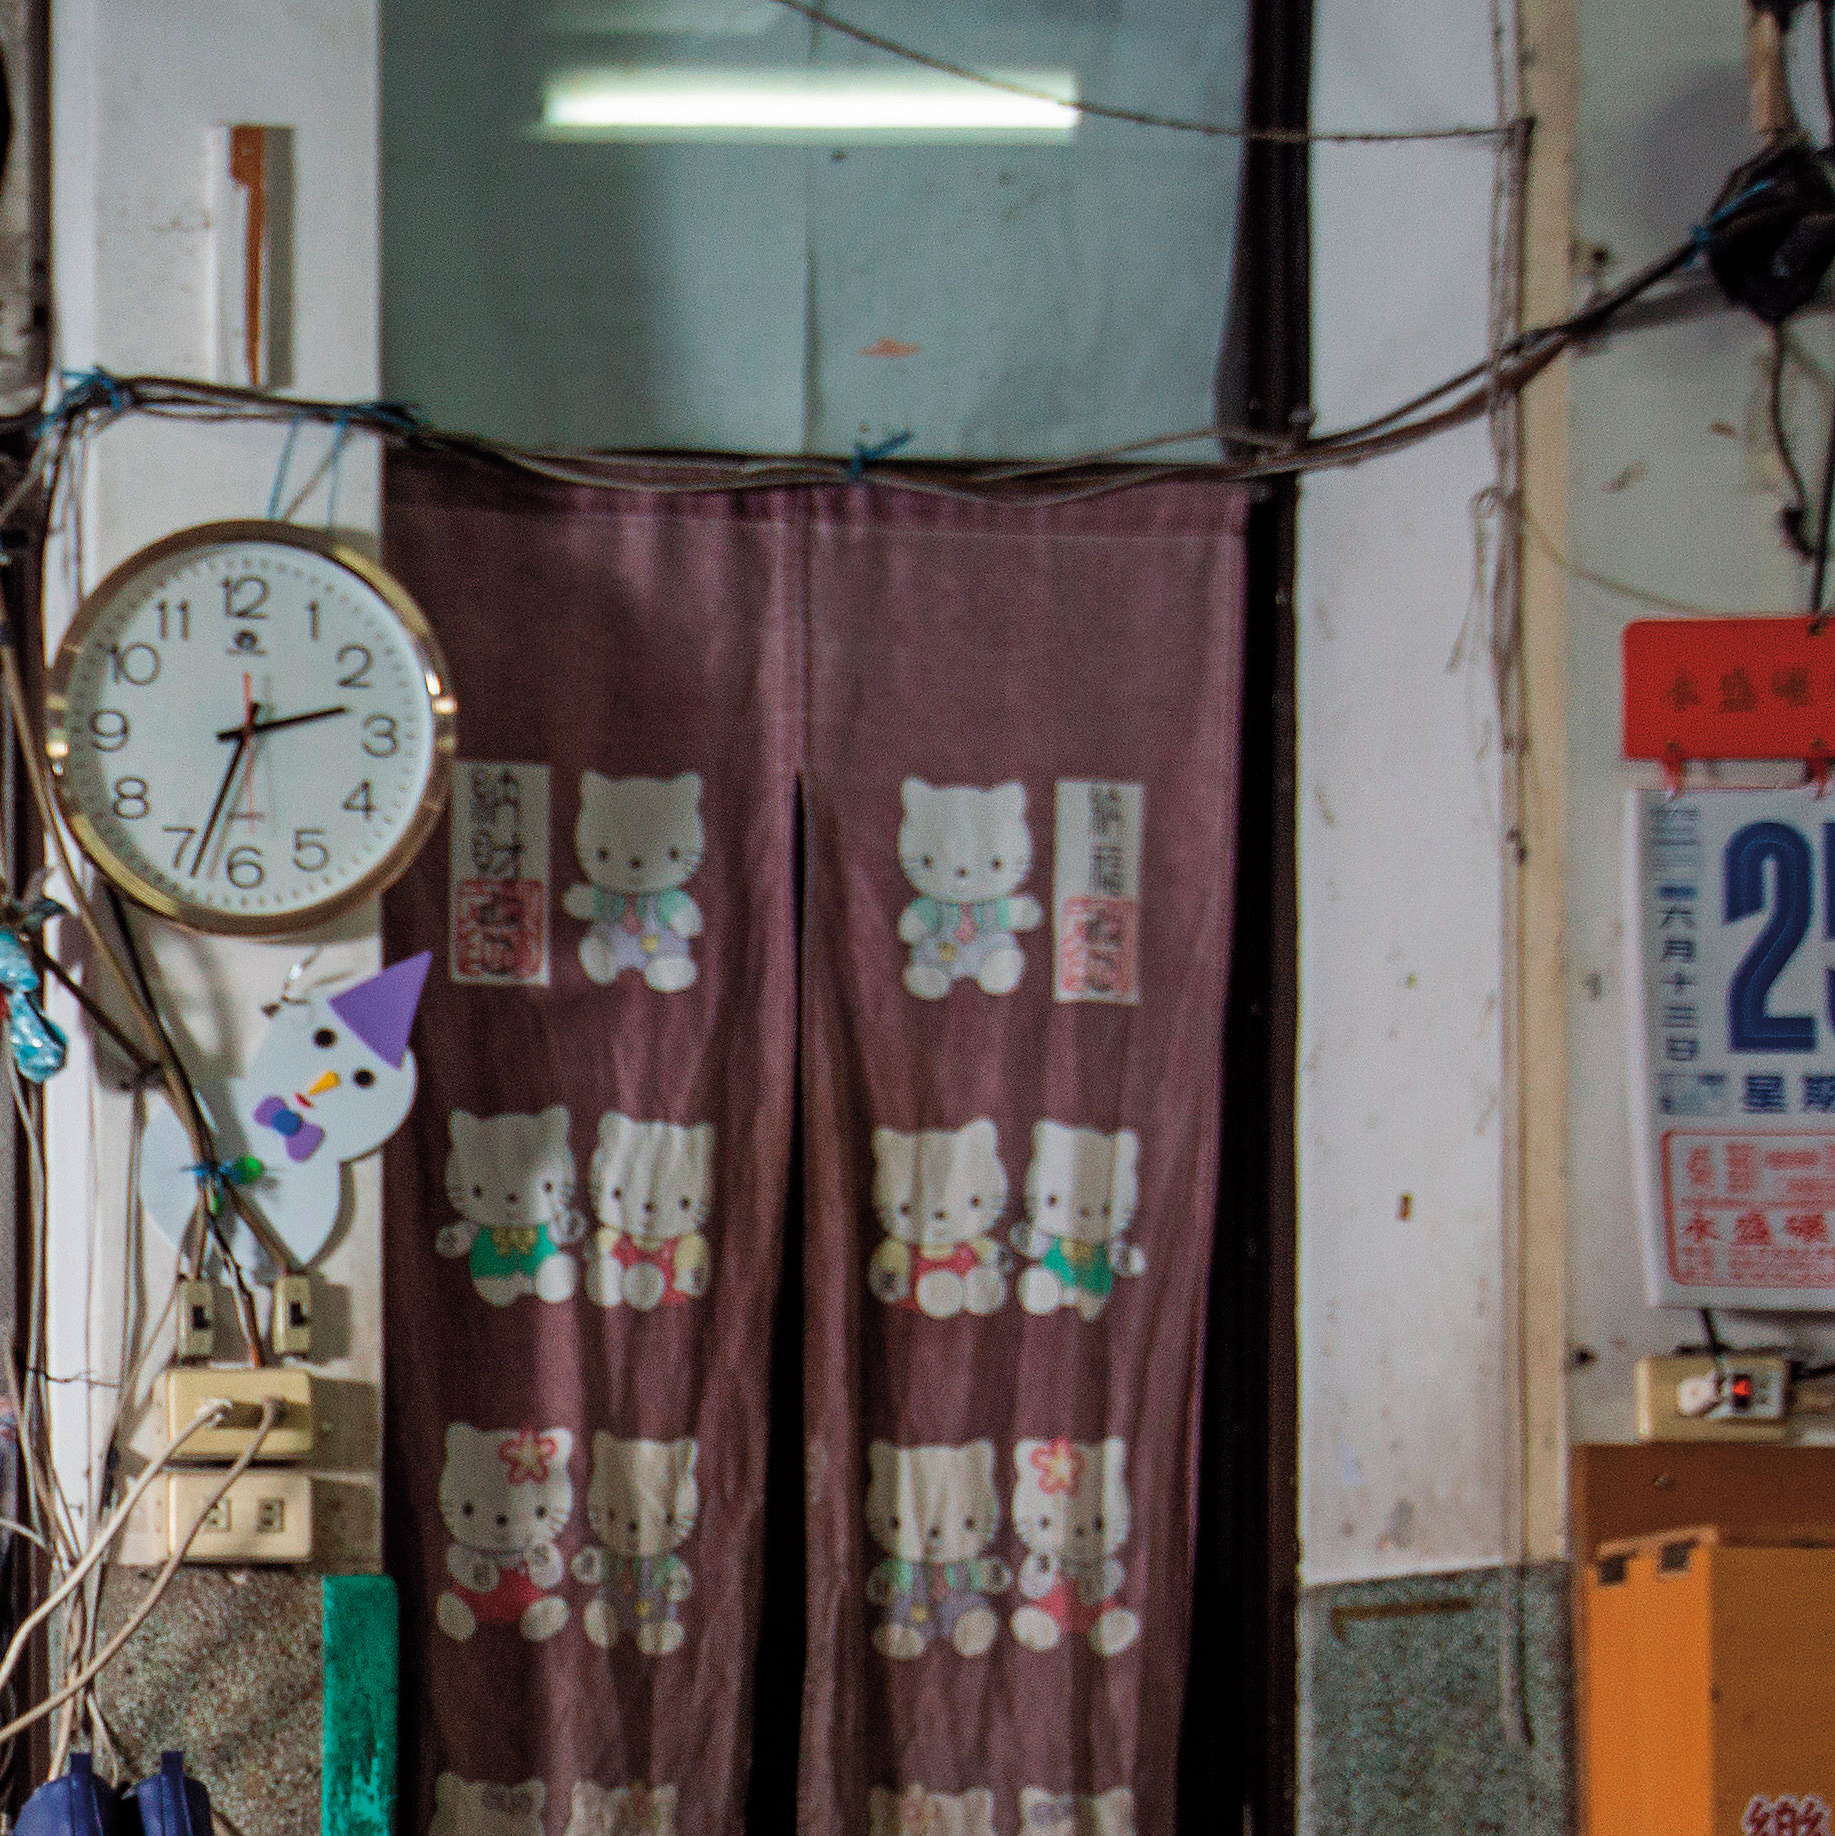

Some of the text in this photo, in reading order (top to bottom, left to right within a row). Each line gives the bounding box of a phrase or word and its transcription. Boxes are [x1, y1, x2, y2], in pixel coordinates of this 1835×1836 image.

[221, 573, 270, 620] 12
[155, 600, 190, 640] 11
[306, 600, 320, 640] 1
[111, 640, 161, 686] 10
[335, 643, 374, 688] 2
[89, 709, 129, 752] 9
[361, 712, 400, 758] 3
[113, 776, 150, 820] 8
[342, 779, 376, 821] 4
[163, 826, 197, 869] 7
[227, 845, 265, 889] 6
[292, 828, 330, 871] 5
[1721, 820, 1835, 1055] 2
